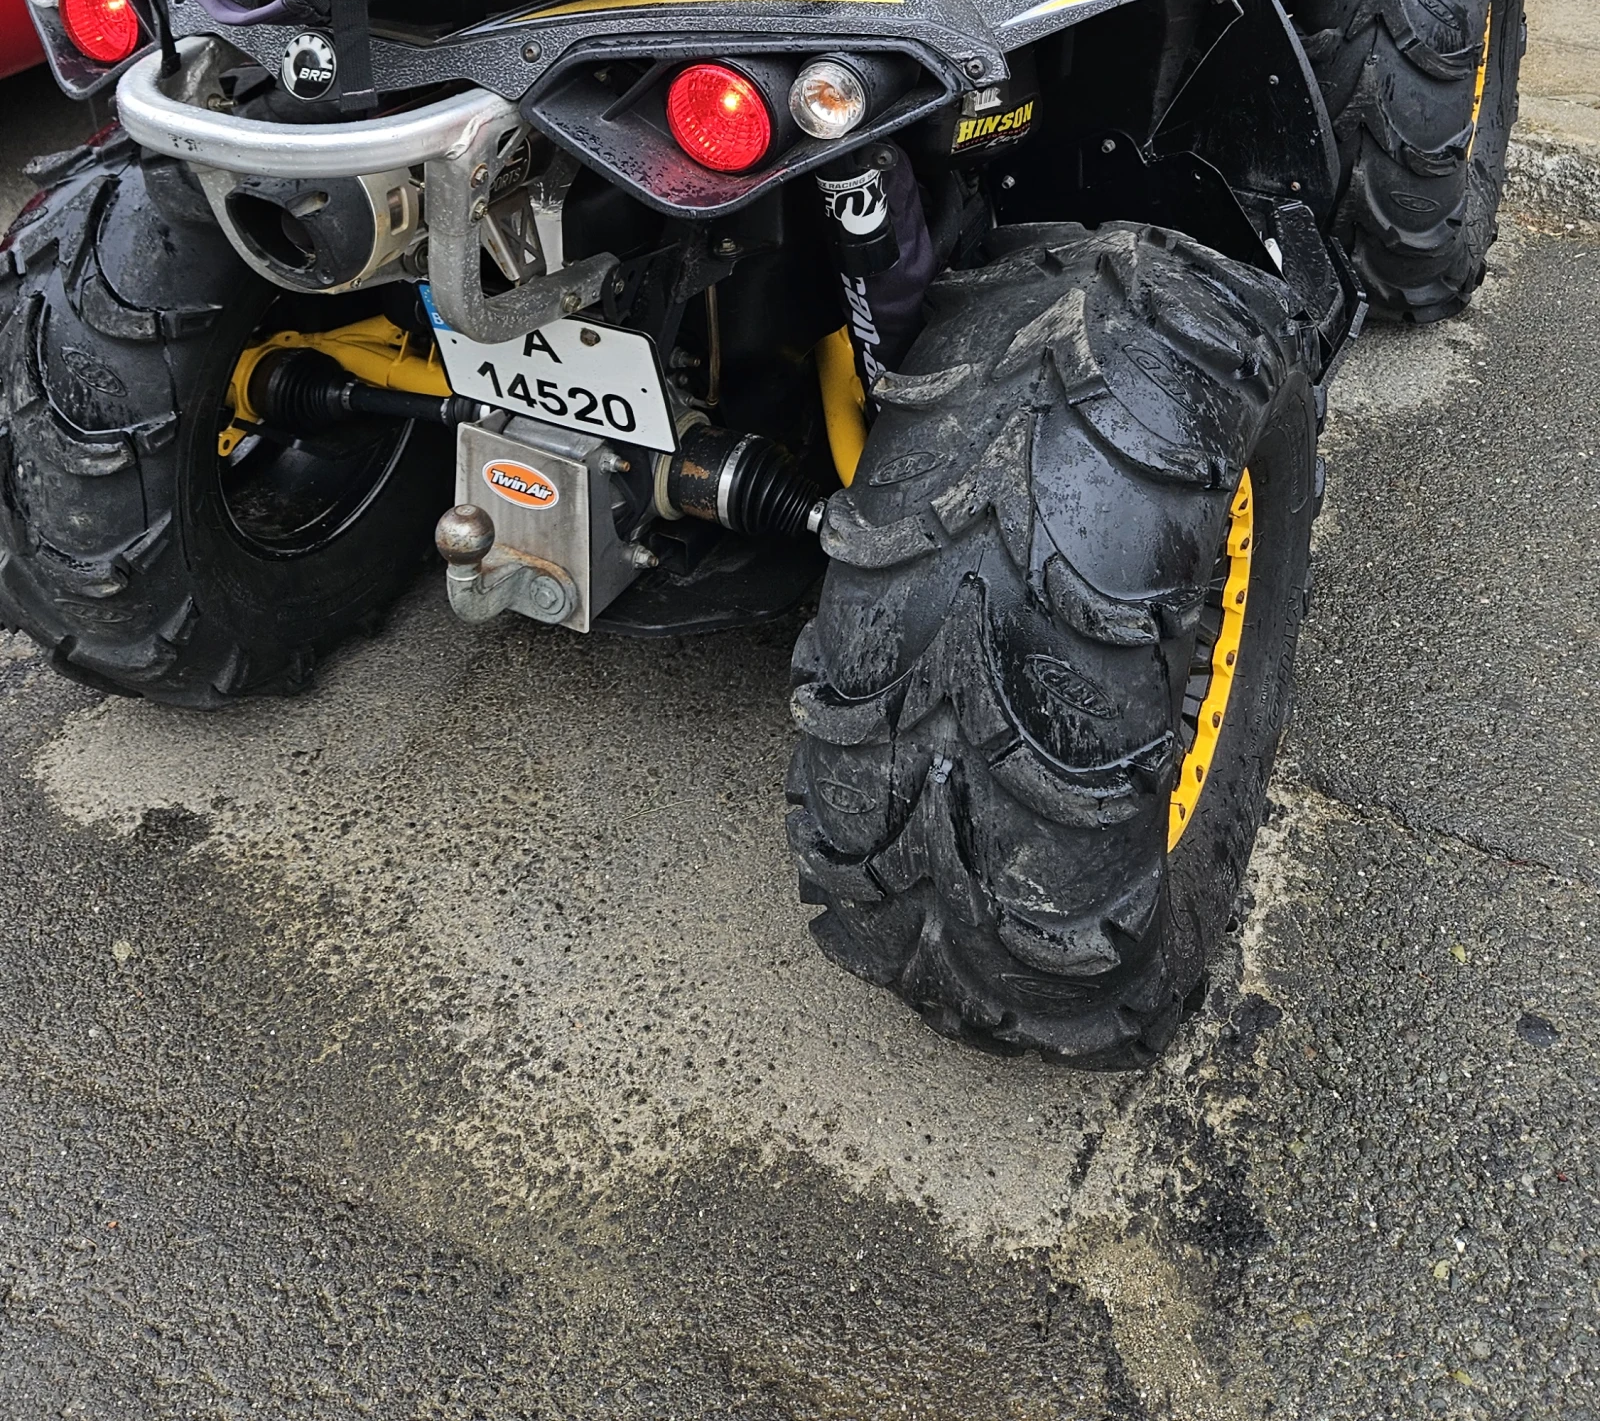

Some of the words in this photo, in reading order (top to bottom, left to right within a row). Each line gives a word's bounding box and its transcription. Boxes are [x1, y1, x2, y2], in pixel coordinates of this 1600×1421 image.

[299, 67, 332, 82] BRP
[957, 100, 1034, 143] HINSON
[828, 177, 866, 189] RACING
[523, 329, 563, 364] A
[477, 361, 637, 433] 14520
[491, 468, 528, 493] Twin
[525, 482, 554, 500] Air
